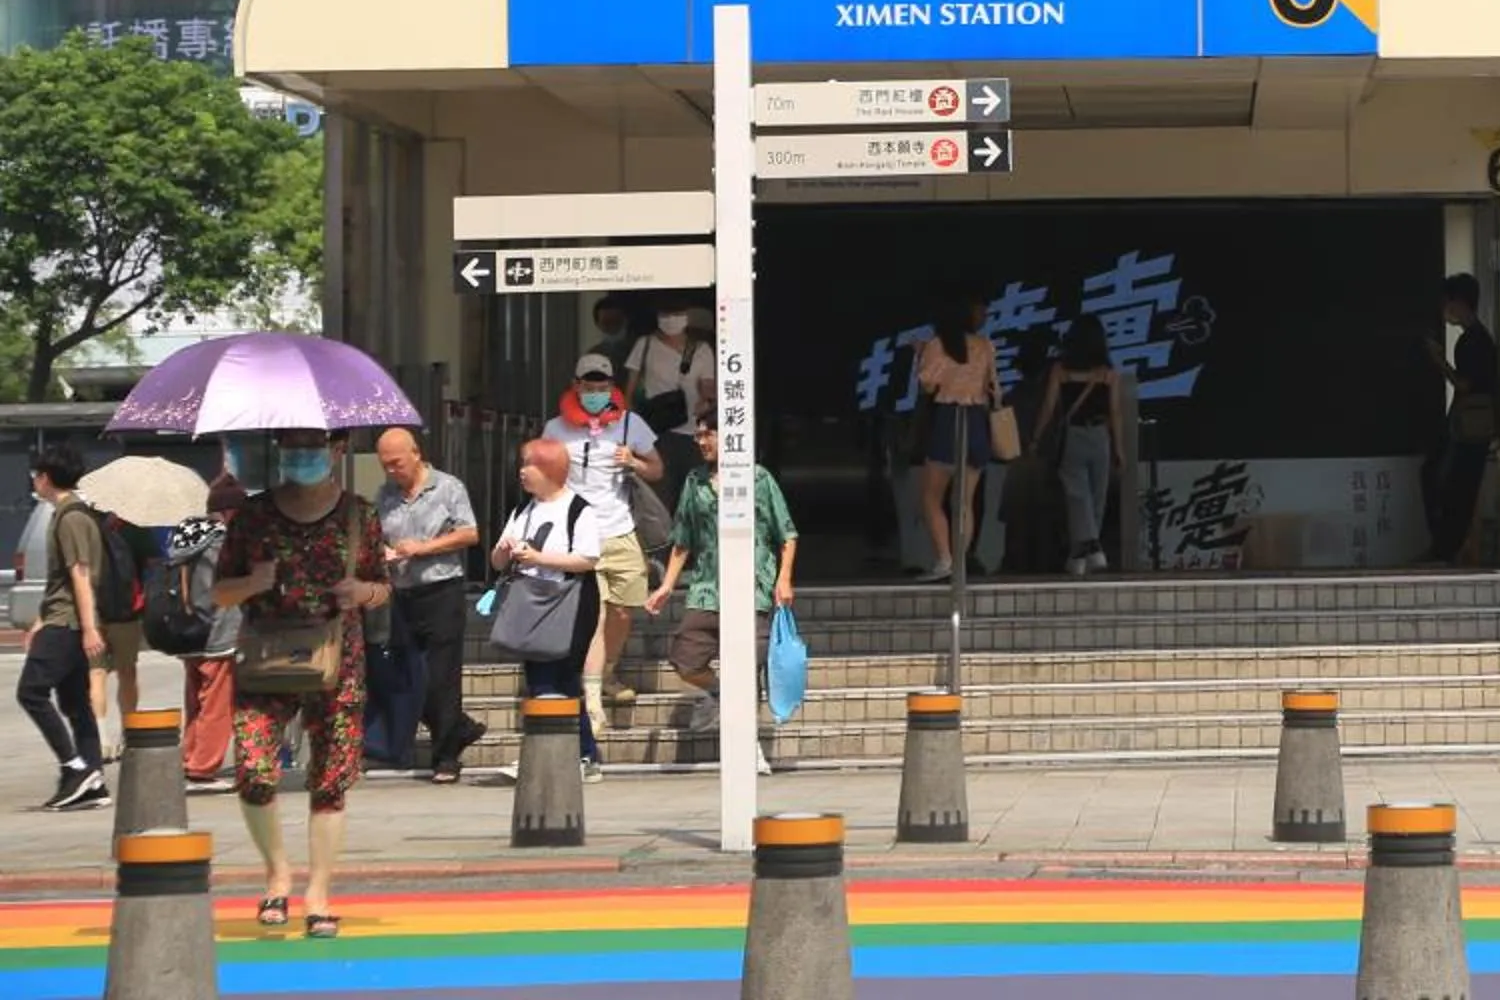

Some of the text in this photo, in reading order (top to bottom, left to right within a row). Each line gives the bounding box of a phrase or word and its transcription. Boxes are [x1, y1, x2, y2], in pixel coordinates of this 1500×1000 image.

[835, 1, 1064, 27] XIMEN STATION
[723, 352, 746, 454] 6號彩虹
